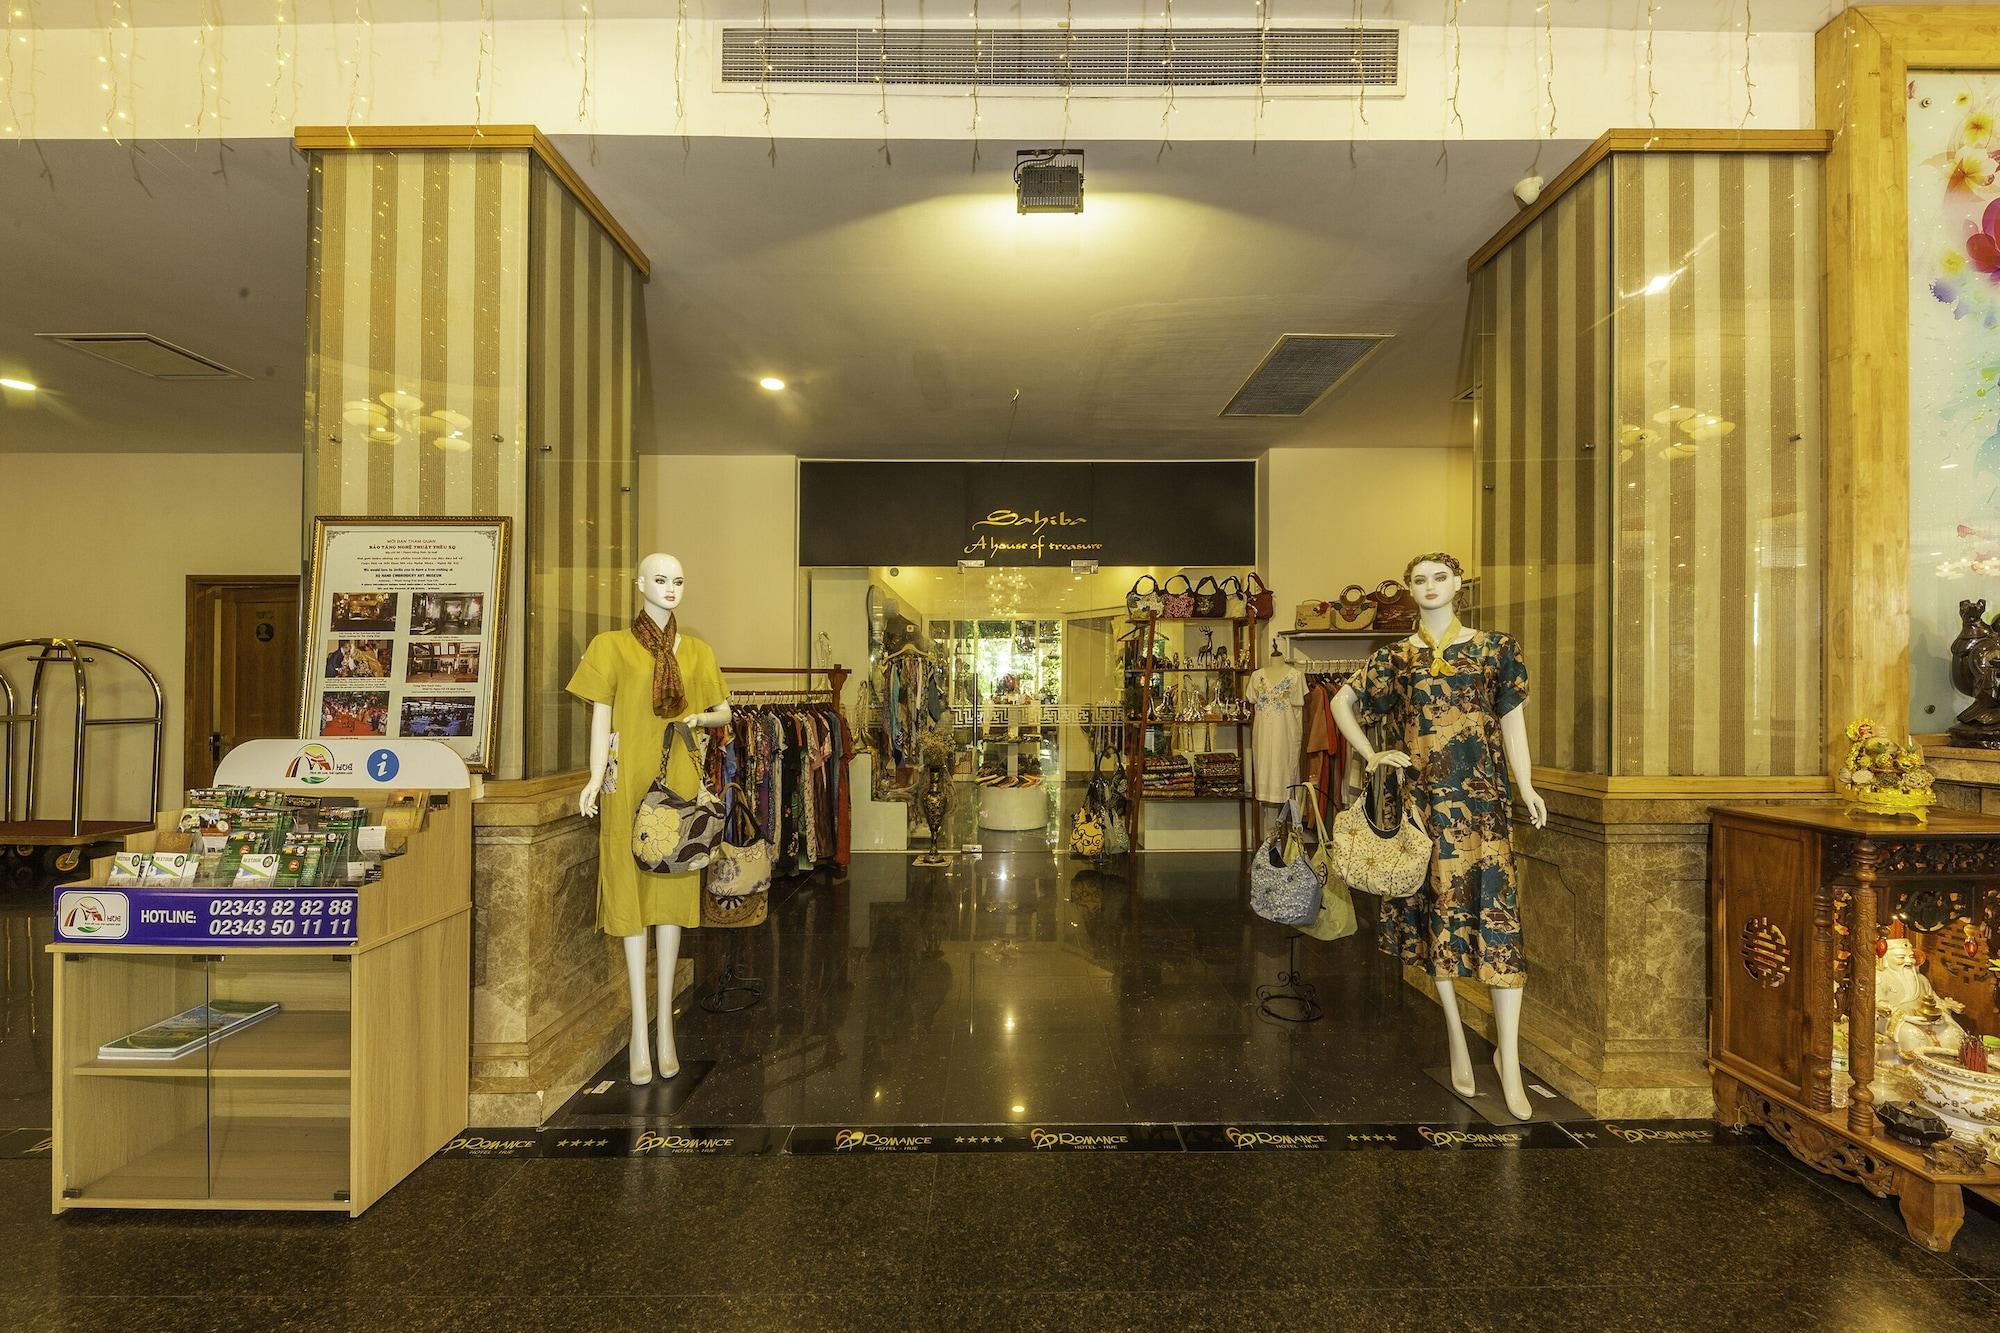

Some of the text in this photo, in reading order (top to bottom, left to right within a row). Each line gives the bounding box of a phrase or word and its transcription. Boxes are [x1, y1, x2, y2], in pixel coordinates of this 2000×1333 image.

[964, 535, 1103, 559] A house of treasure
[208, 899, 353, 916] 02343 82 82 88
[140, 909, 197, 924] HOTLINE:
[208, 919, 351, 935] 02343 50 11 11
